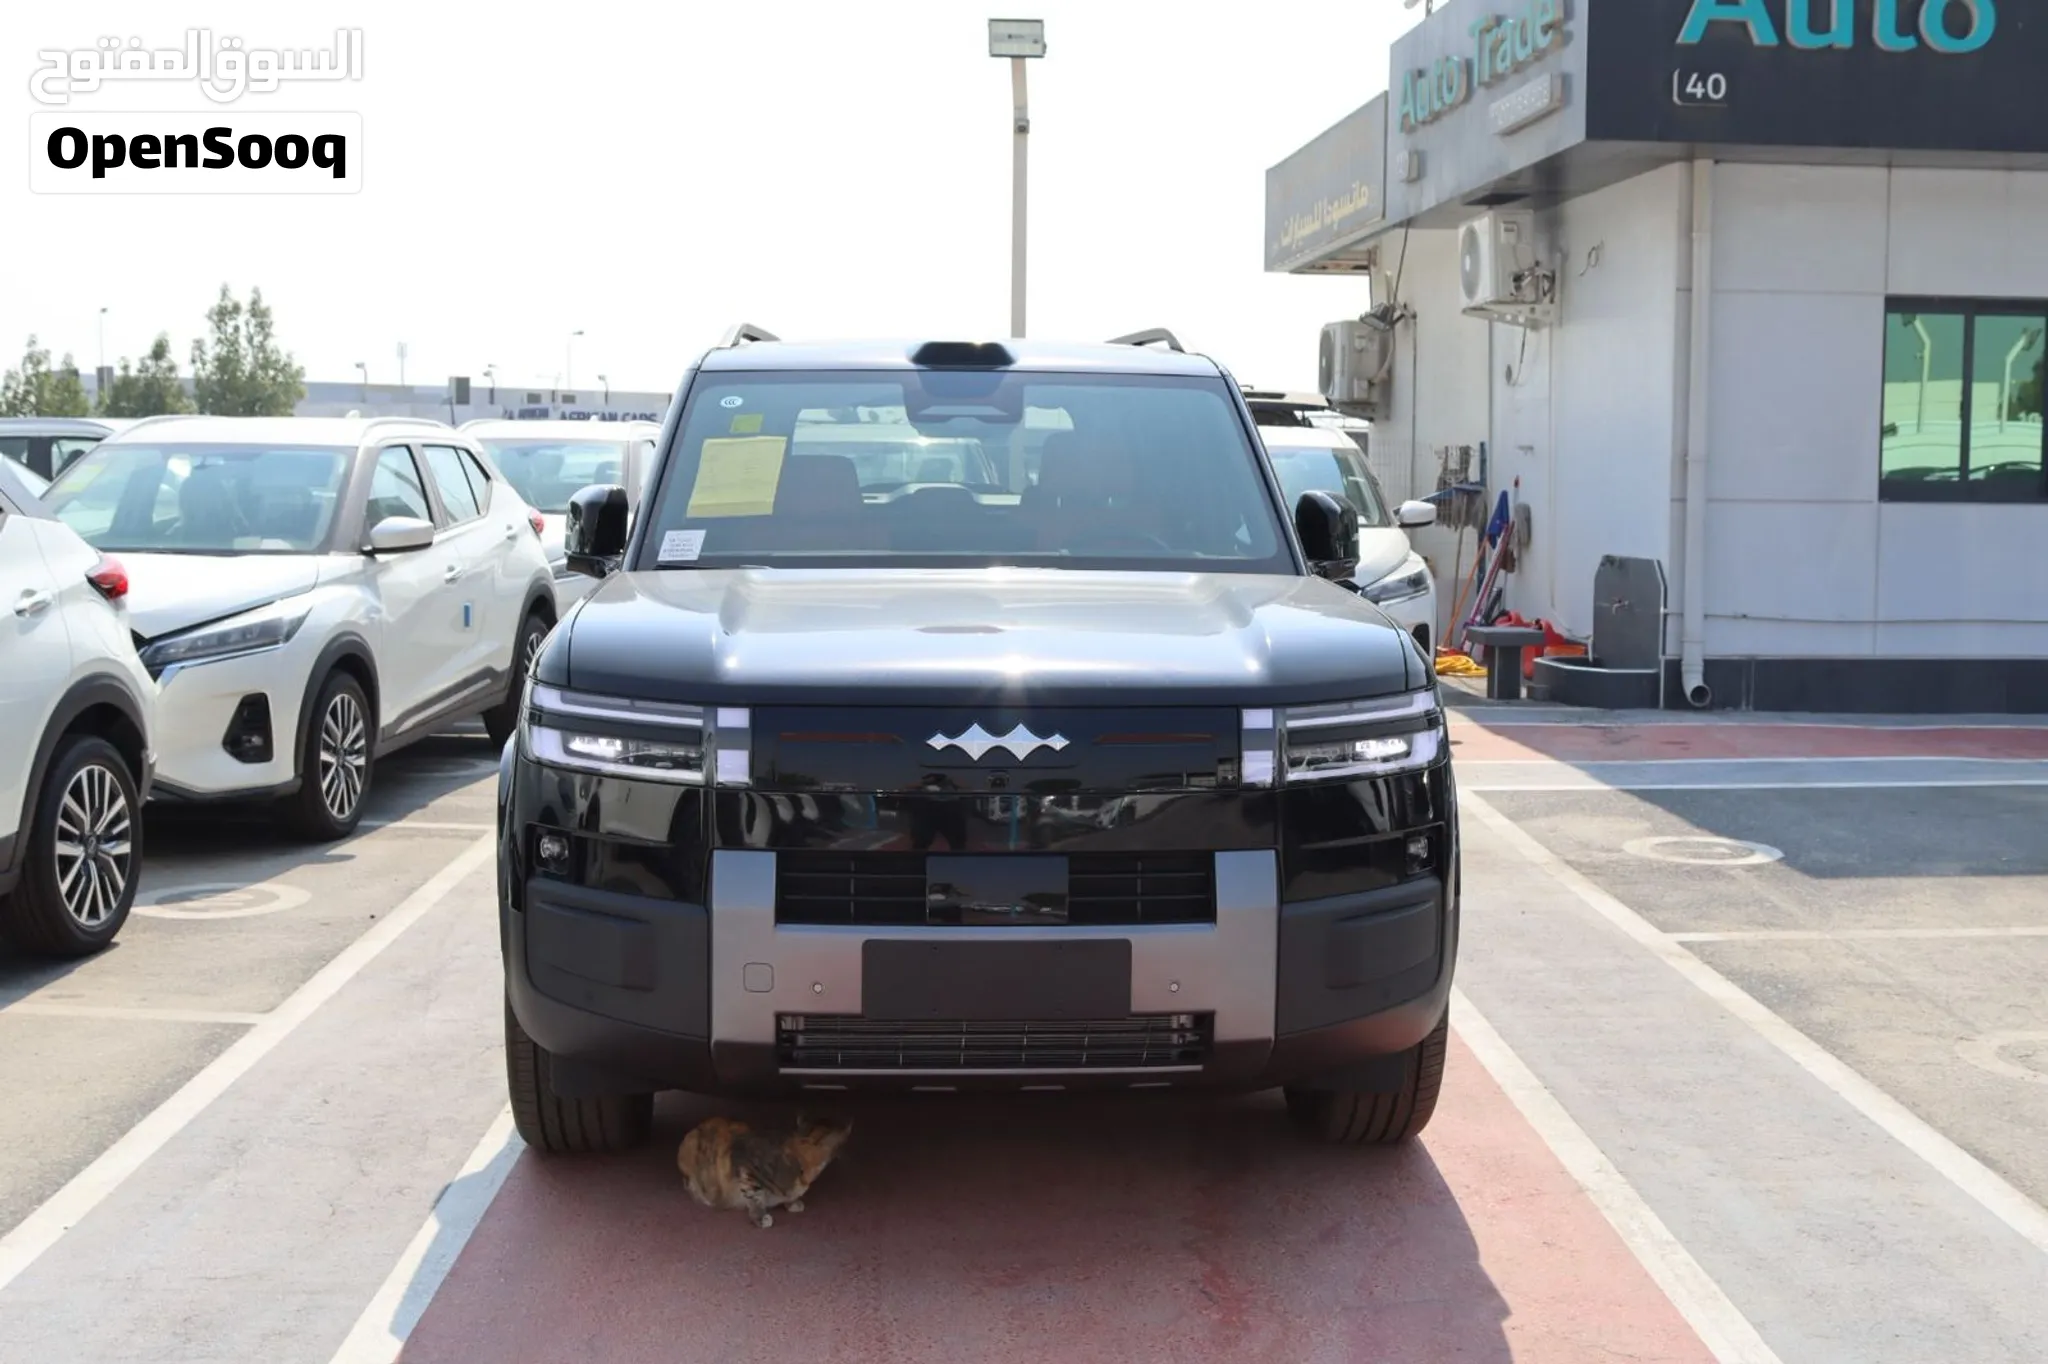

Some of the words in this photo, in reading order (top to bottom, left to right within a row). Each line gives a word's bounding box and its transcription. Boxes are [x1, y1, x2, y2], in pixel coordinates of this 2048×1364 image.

[1676, 0, 1997, 54] Auto
[1397, 55, 1466, 134] Auto
[1468, 0, 1564, 88] Trade
[1685, 73, 1727, 100] 40
